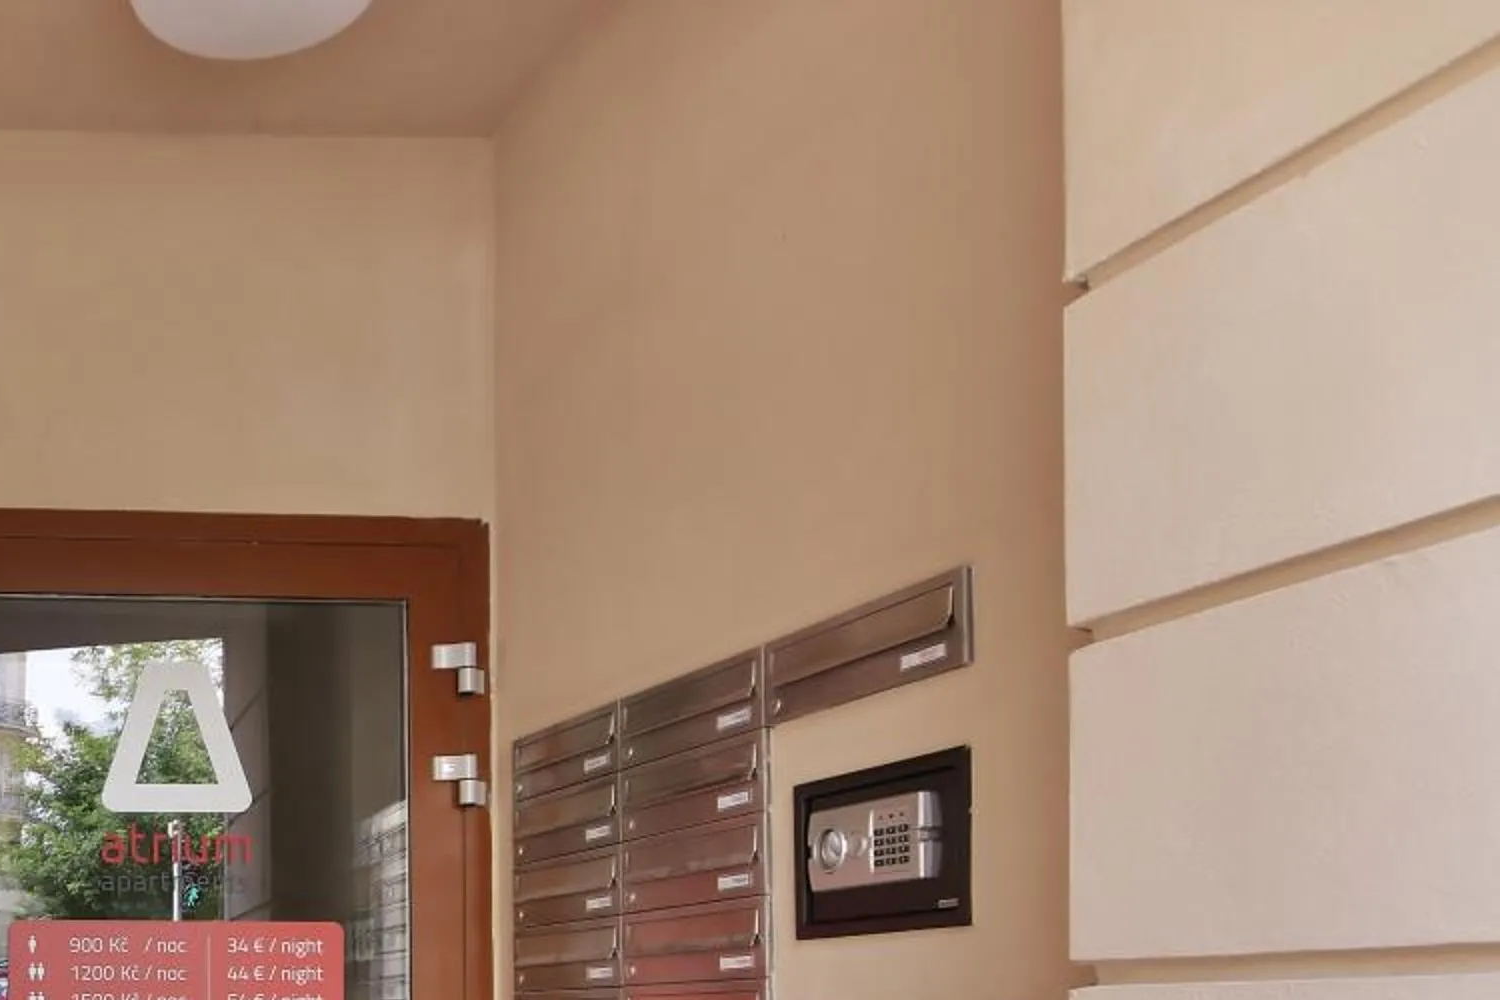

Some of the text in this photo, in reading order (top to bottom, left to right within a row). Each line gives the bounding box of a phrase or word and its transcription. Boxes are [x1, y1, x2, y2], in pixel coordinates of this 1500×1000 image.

[101, 821, 254, 865] atrium
[69, 936, 188, 953] 900 Kč / noc
[227, 937, 324, 957] 34 € / night
[71, 964, 188, 981] 1200 Kč / noc
[227, 965, 324, 985] 44 € / night
